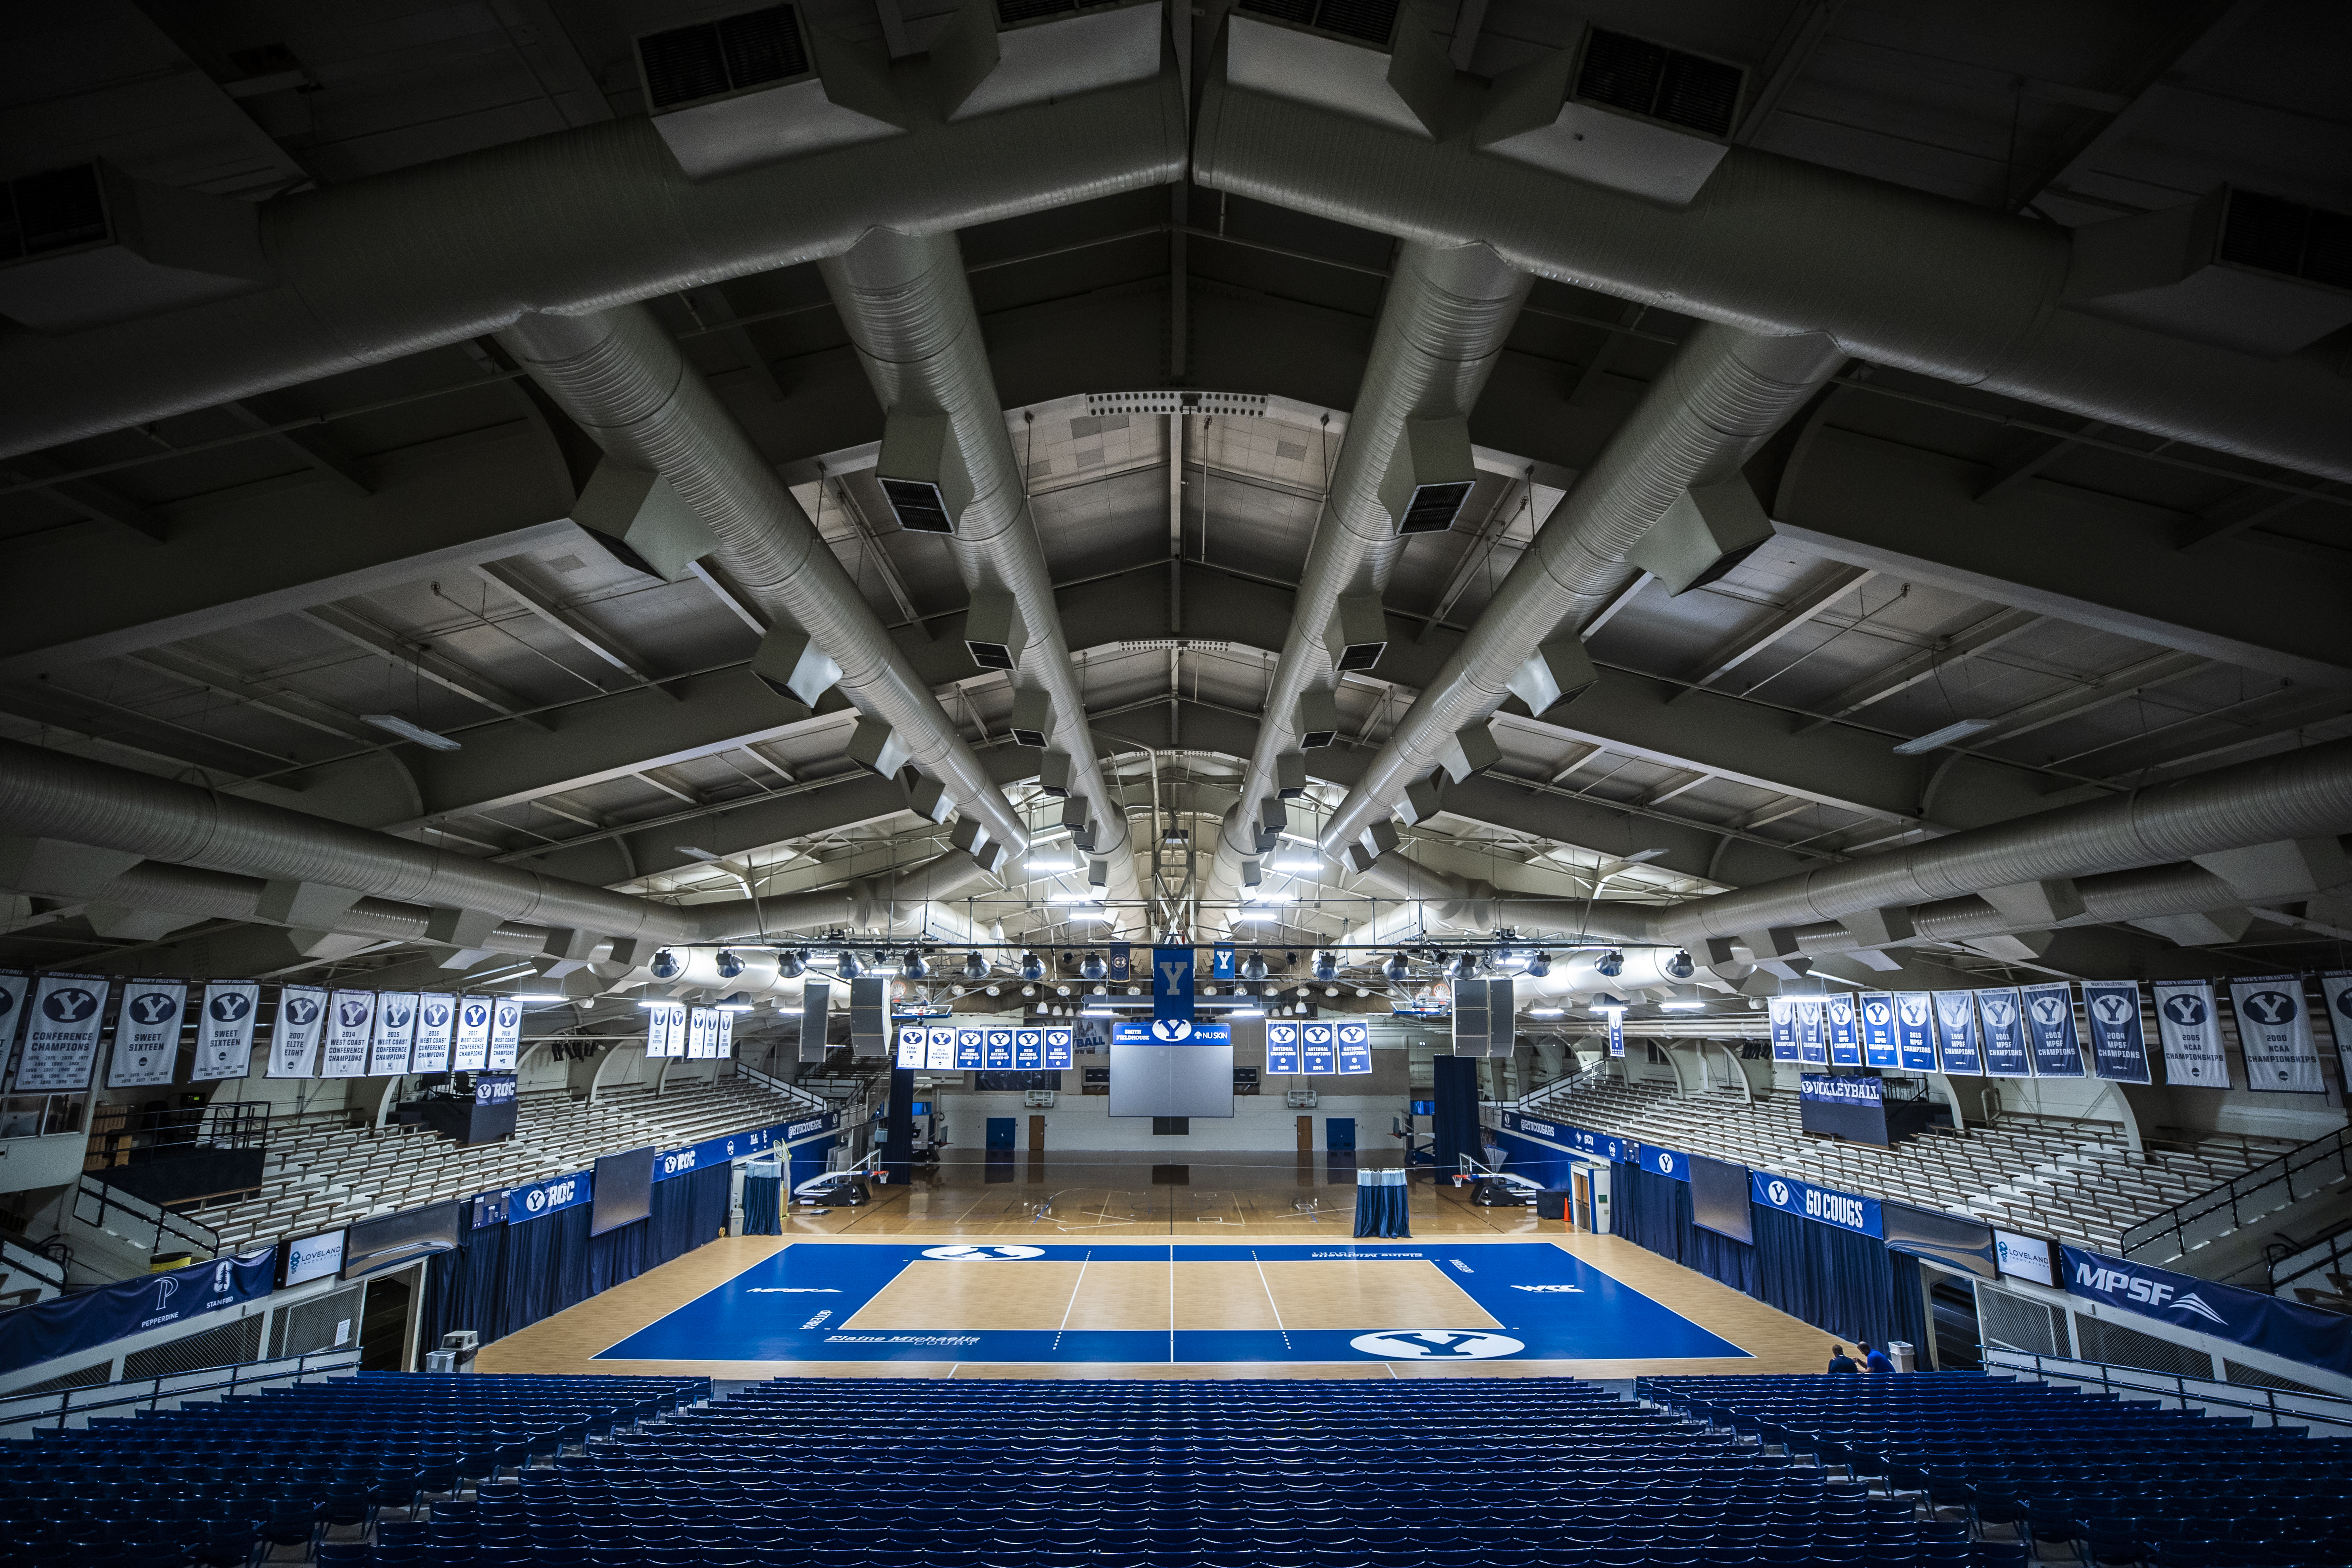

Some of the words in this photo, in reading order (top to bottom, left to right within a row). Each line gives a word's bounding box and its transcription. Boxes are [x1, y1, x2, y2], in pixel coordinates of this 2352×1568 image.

[33, 1032, 93, 1041] CONFERENCE
[210, 1039, 240, 1047] SIXTEEN
[31, 1043, 90, 1051] CHAMPIONS
[2098, 1050, 2140, 1058] CHAMPIONS
[2166, 1053, 2224, 1061] CHAMPIONSHIPS
[493, 1082, 515, 1097] ROC
[1813, 1081, 1880, 1100] VOLLEYBALL
[1521, 1119, 1554, 1137] @BYUCOUGARS
[1584, 1135, 1593, 1146] GCU
[677, 1150, 695, 1170] ROC
[548, 1181, 575, 1207] ROC
[1806, 1189, 1821, 1217] GO
[1823, 1193, 1863, 1228] COUGS
[301, 1254, 340, 1265] INNOVATIONS
[302, 1246, 341, 1261] LOVELAND
[2009, 1249, 2048, 1264] LOVELAND
[2010, 1256, 2049, 1269] INNOVATIONS
[2076, 1263, 2174, 1306] MPSF
[207, 1296, 233, 1308] STANFORD
[142, 1312, 178, 1328] PEPPERDINE
